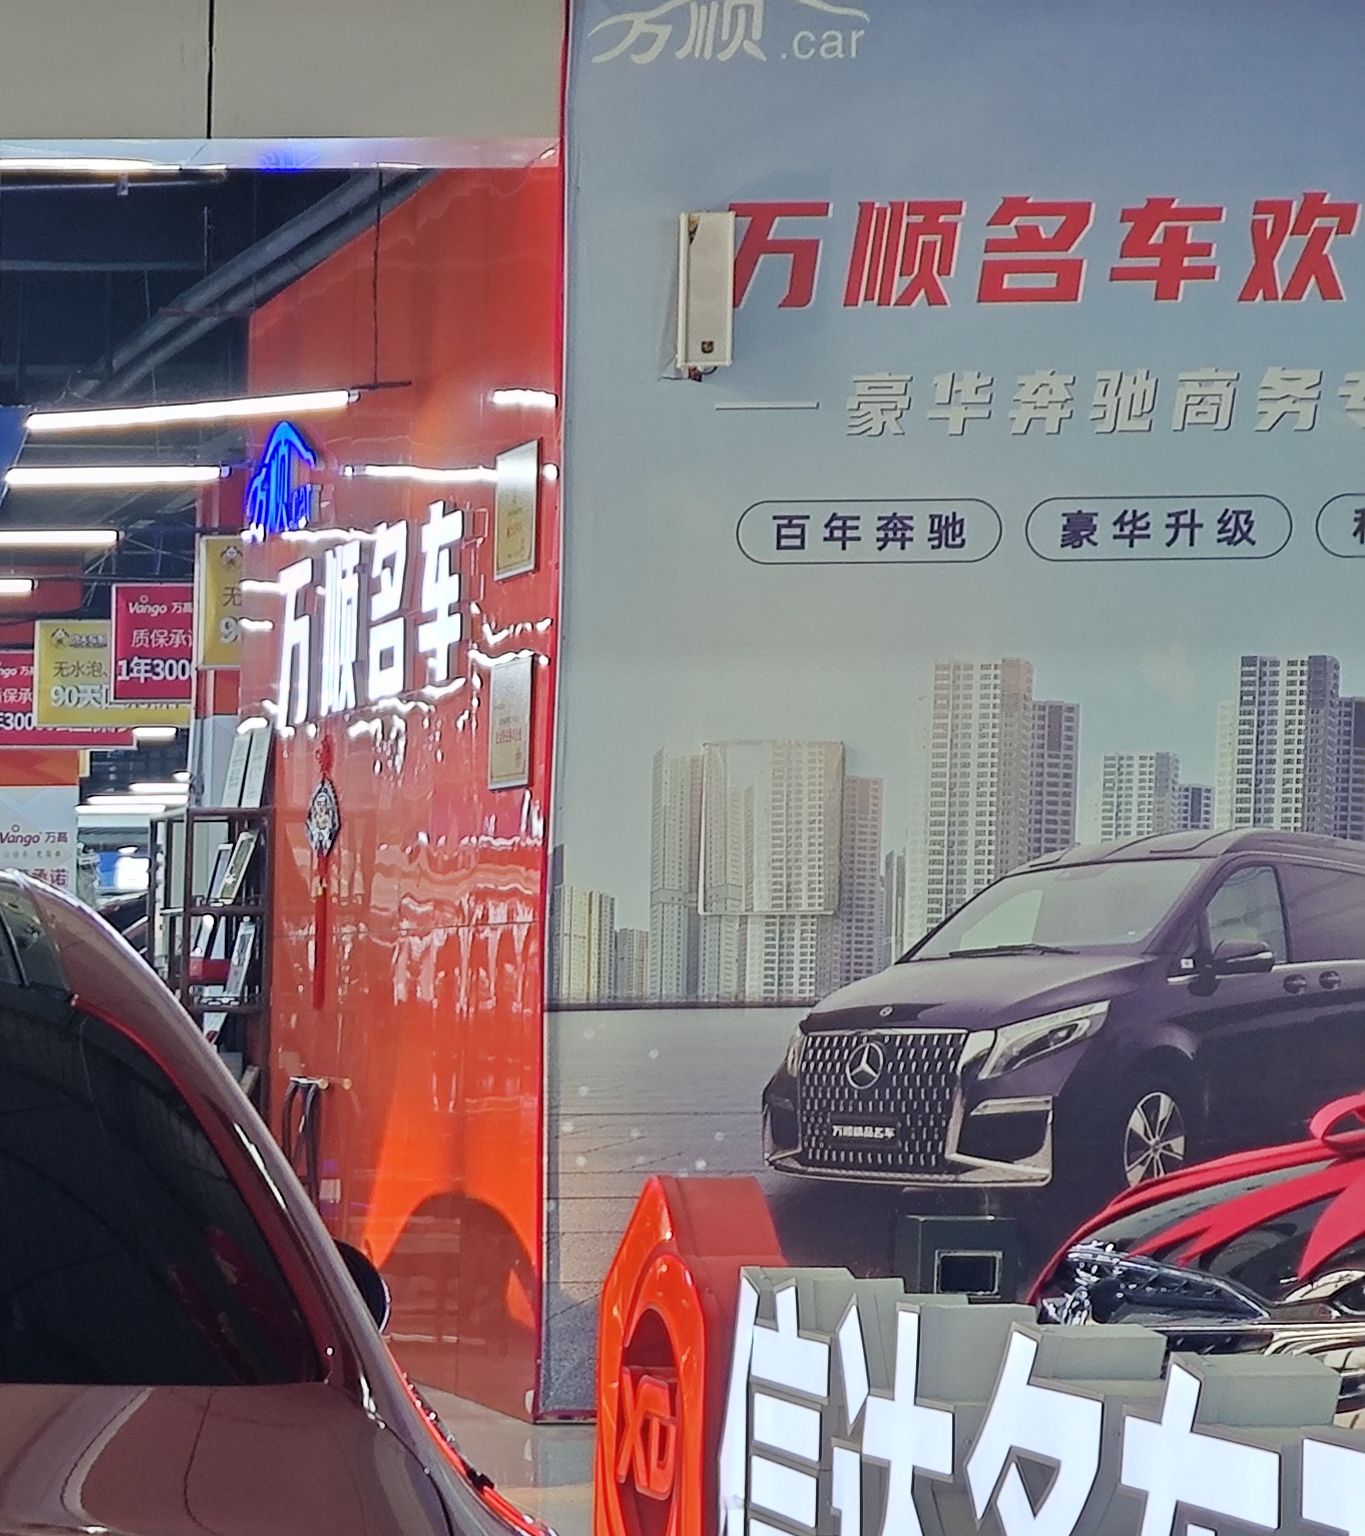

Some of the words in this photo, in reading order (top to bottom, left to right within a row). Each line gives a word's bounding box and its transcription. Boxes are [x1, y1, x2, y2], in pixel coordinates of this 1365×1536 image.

[727, 191, 1360, 310] 万顺名车欢
[772, 513, 967, 552] 百年奔驰
[1060, 509, 1257, 549] 豪华升级
[129, 602, 168, 616] Vango
[276, 502, 465, 730] 万顺名车
[0, 829, 40, 846] Vango
[26, 868, 67, 886] 承诺
